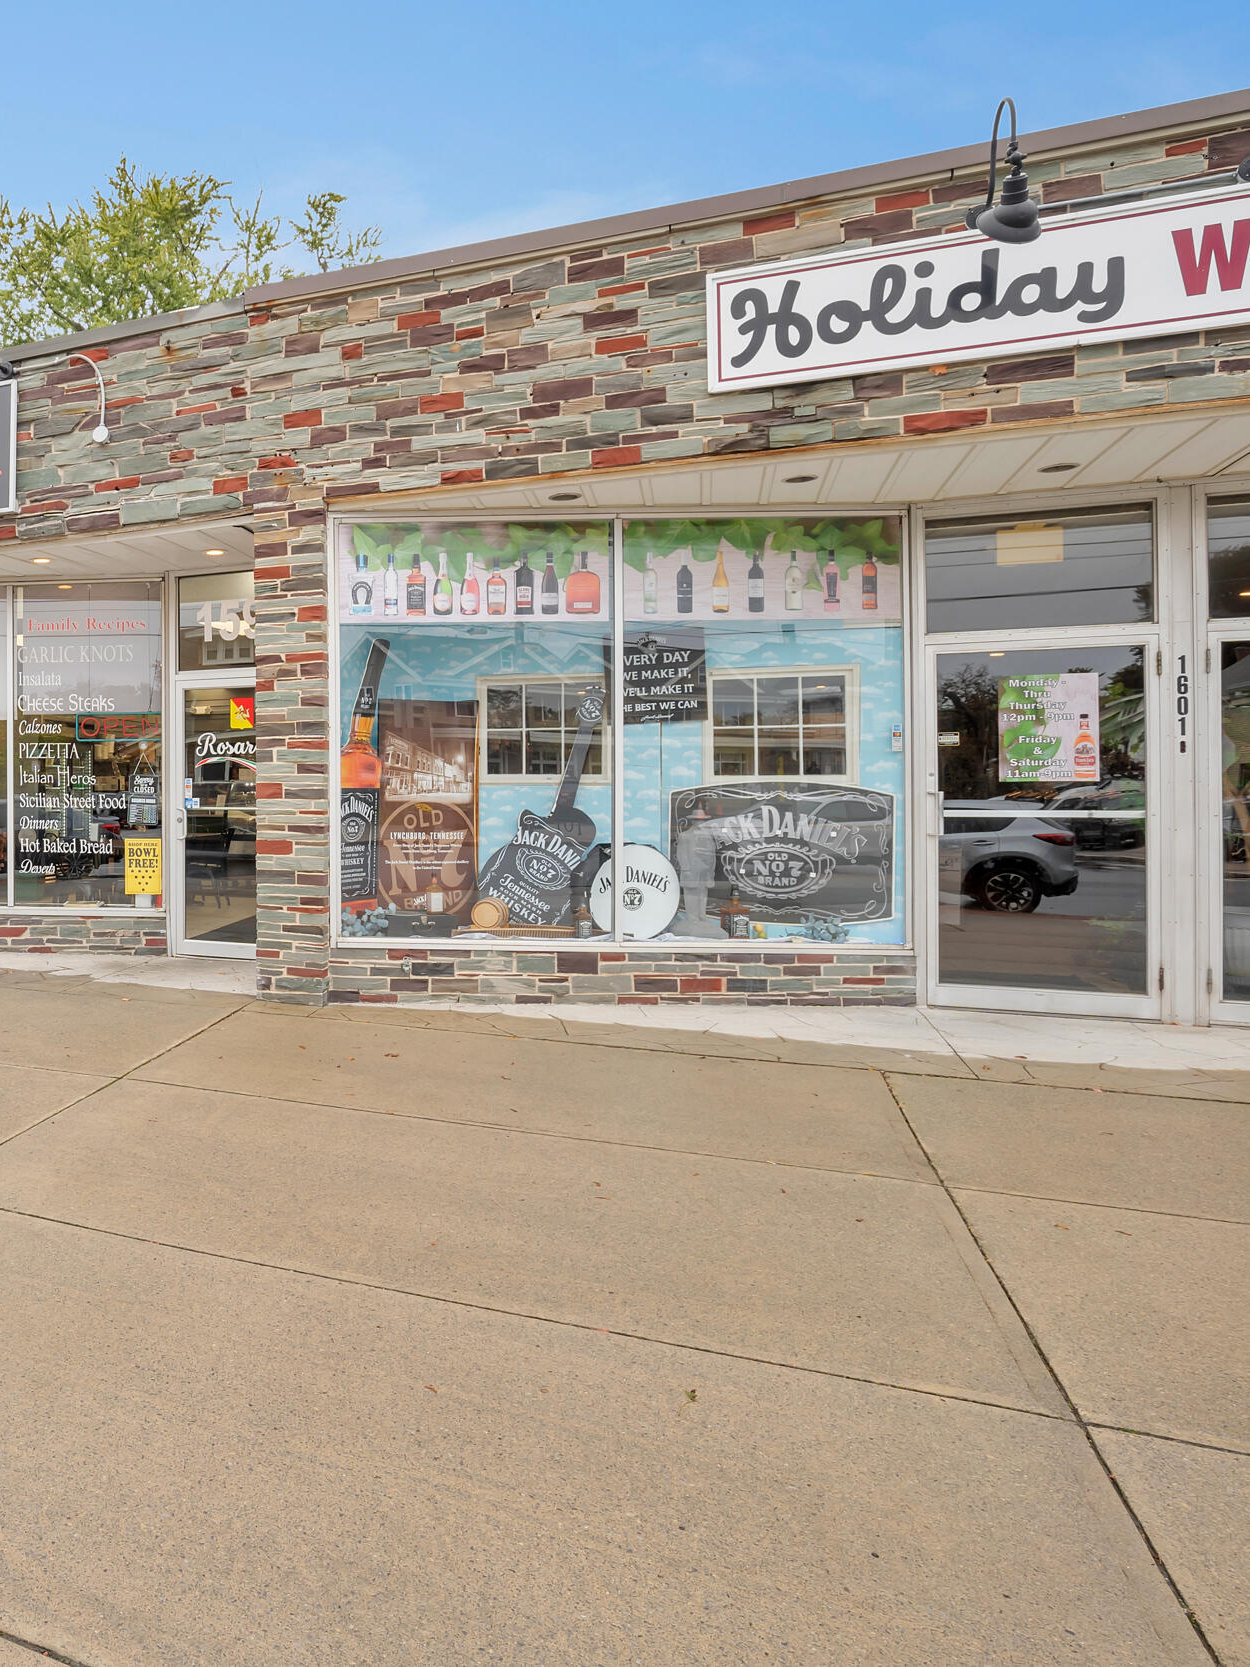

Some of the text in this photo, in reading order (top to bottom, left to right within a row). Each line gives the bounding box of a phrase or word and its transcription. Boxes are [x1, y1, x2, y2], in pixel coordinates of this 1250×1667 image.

[730, 248, 1125, 368] Holiday
[27, 616, 147, 633] Family Recipes
[17, 644, 134, 664] GARLIC KNOTS
[662, 650, 691, 664] DAY
[18, 670, 63, 687] Insalata
[623, 667, 692, 681] WE MAKE IT,
[650, 684, 683, 696] MAKE
[684, 683, 695, 693] IT
[1009, 678, 1059, 689] Monday
[1023, 690, 1051, 699] Thru
[635, 701, 658, 712] BEST
[659, 701, 676, 710] WE
[677, 699, 699, 709] CAN
[1009, 701, 1068, 711] Thursday
[1002, 712, 1037, 723] 12pm
[1046, 712, 1075, 723] 9pm
[18, 718, 63, 736] Calzones
[80, 716, 160, 738] OPEN
[1018, 735, 1058, 745] Friday
[19, 742, 81, 760] PIZZETTA
[1032, 746, 1044, 755] &
[1009, 758, 1068, 768] Saturday
[19, 765, 97, 787] Italian Heros
[133, 786, 155, 794] CLOSED
[19, 792, 127, 810] Sicilian Street Food
[18, 815, 59, 830] Dinners
[403, 808, 444, 829] OLD
[430, 831, 465, 840] TENNESSEE
[513, 827, 549, 850] JACK
[711, 805, 868, 864] ACK DANIEL'S
[20, 837, 114, 855] Hot Baked Bread
[128, 847, 159, 858] BOWL
[128, 858, 159, 869] FREE!
[767, 852, 789, 861] OLD
[19, 859, 56, 874] Desserts
[626, 865, 671, 893] DANIEL'S
[757, 876, 798, 887] BRAND
[499, 873, 551, 913] Tennessee
[519, 880, 540, 896] QUALITY
[488, 886, 547, 926] WHISKEY
